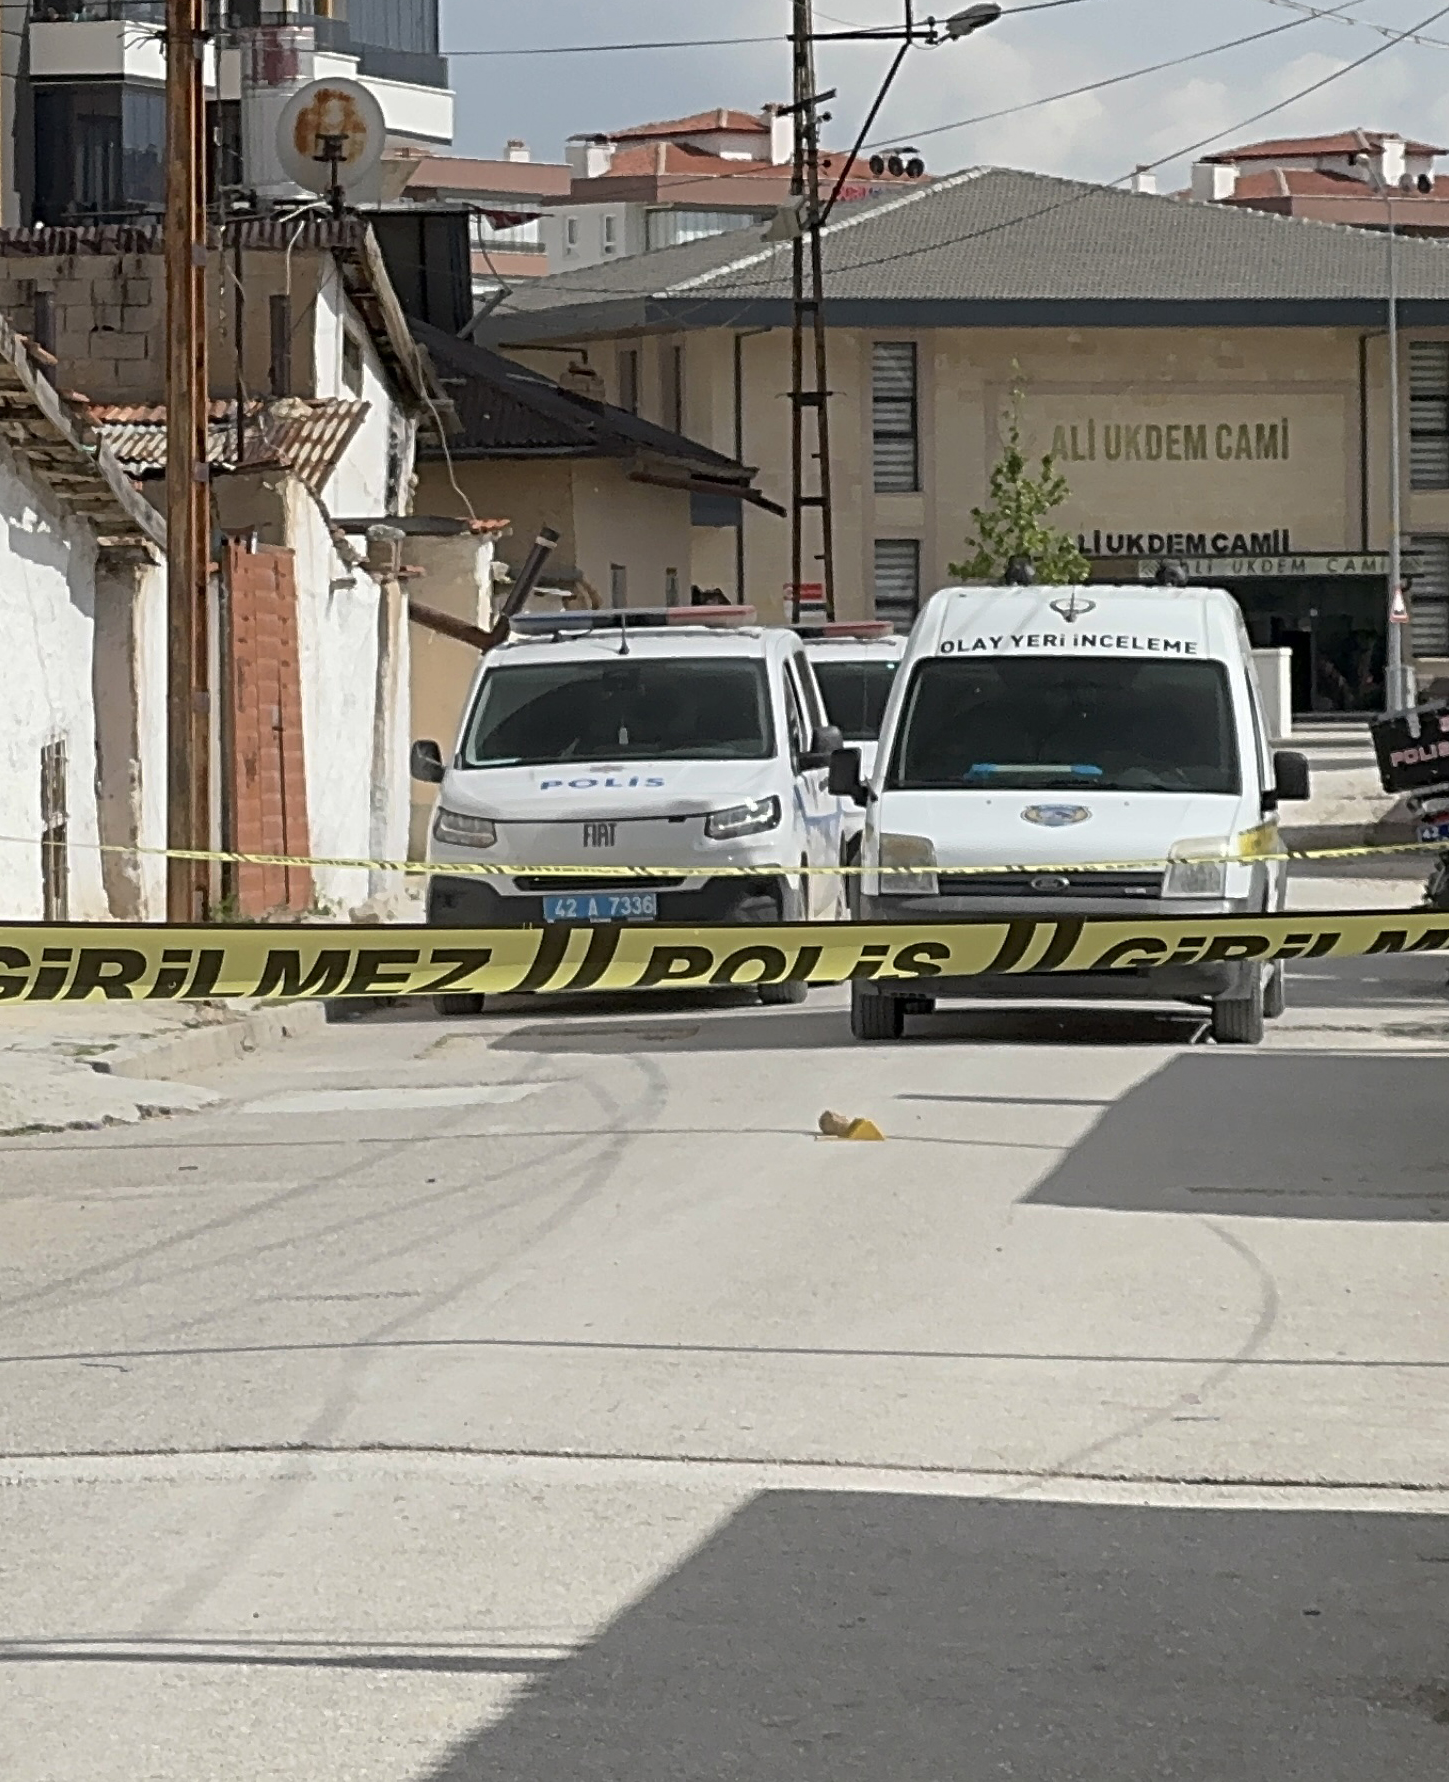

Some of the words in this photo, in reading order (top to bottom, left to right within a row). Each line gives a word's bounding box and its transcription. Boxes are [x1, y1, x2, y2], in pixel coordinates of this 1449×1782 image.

[1052, 418, 1095, 461] ALİ
[1105, 424, 1207, 461] UKDEM
[1216, 417, 1290, 461] CAMİ
[1106, 533, 1206, 554] UKDEM
[1232, 557, 1307, 575] UKDEM
[940, 636, 1003, 655] OLAY
[583, 823, 617, 848] FIAT
[555, 898, 577, 917] 42
[588, 898, 598, 916] A
[608, 896, 652, 916] 7336
